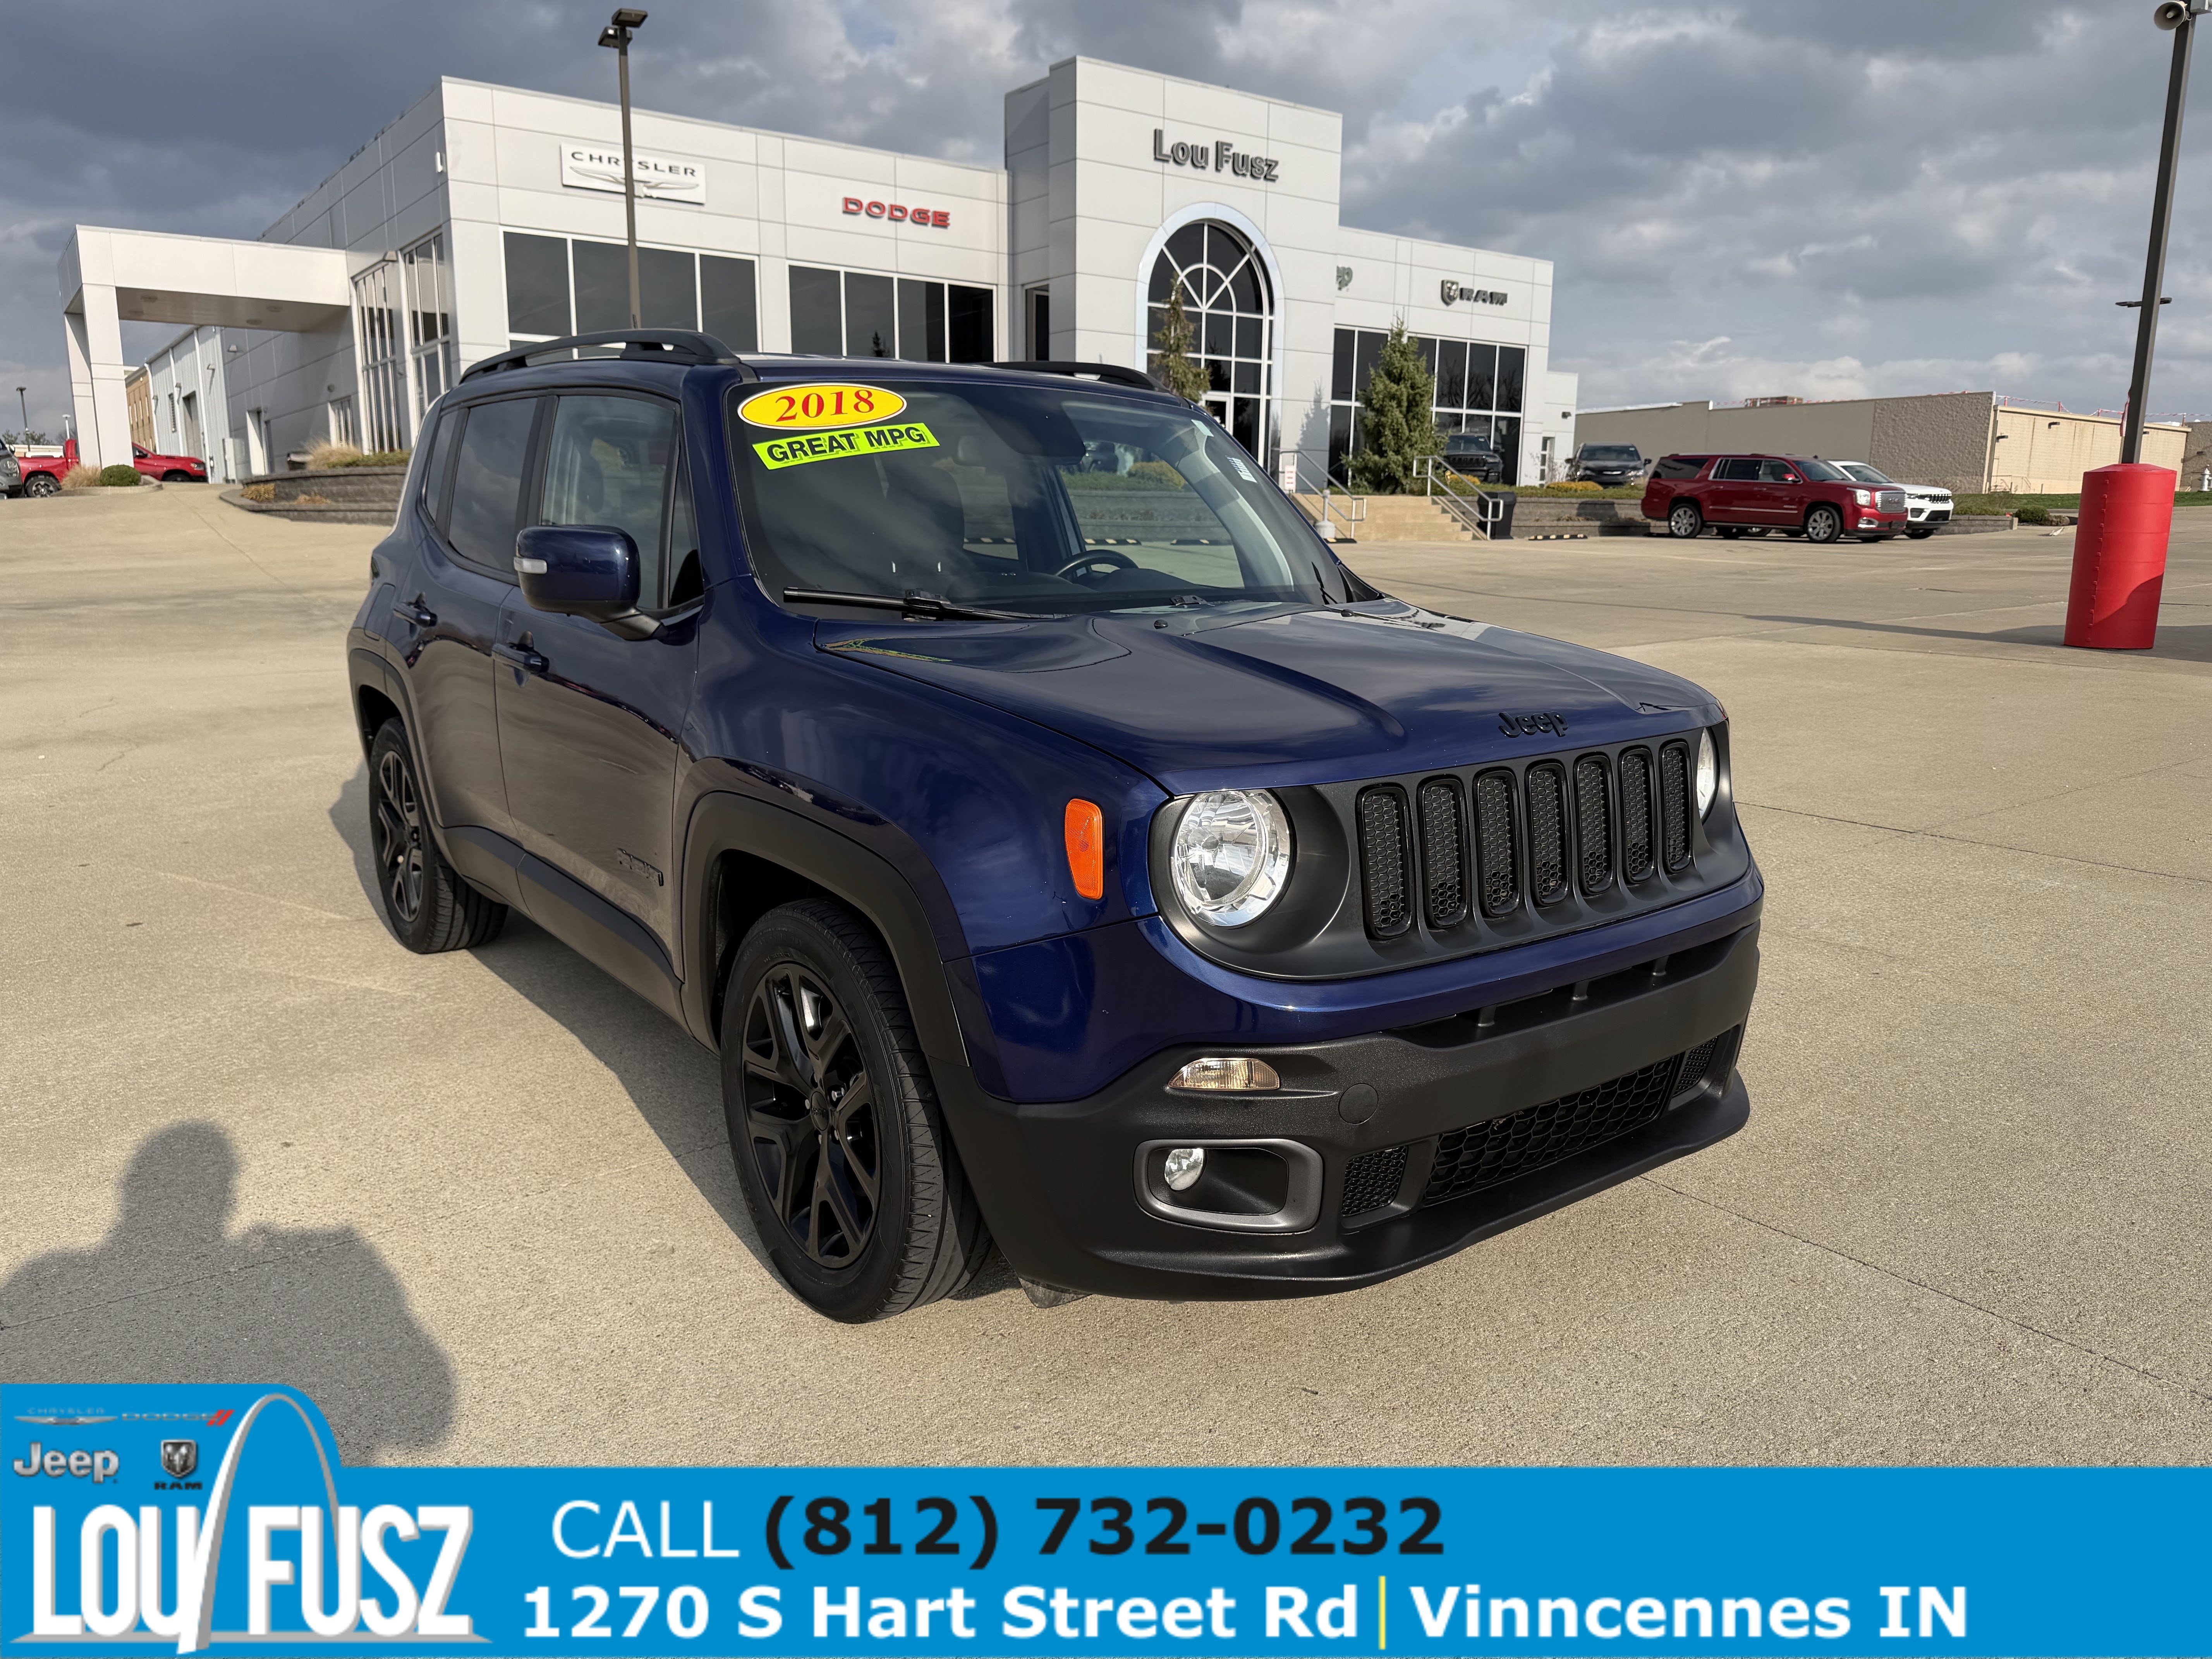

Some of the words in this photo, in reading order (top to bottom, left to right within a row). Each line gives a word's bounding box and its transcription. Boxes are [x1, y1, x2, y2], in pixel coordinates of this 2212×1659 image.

[571, 151, 696, 177] CHRSLER
[1154, 128, 1209, 170] Lou
[1214, 140, 1279, 182] Fusz
[842, 197, 950, 228] DODGE
[1460, 288, 1507, 306] RAM
[775, 390, 874, 422] 2018
[766, 433, 859, 462] GREAT
[865, 426, 926, 448] MPG
[1498, 711, 1569, 738] Jeep
